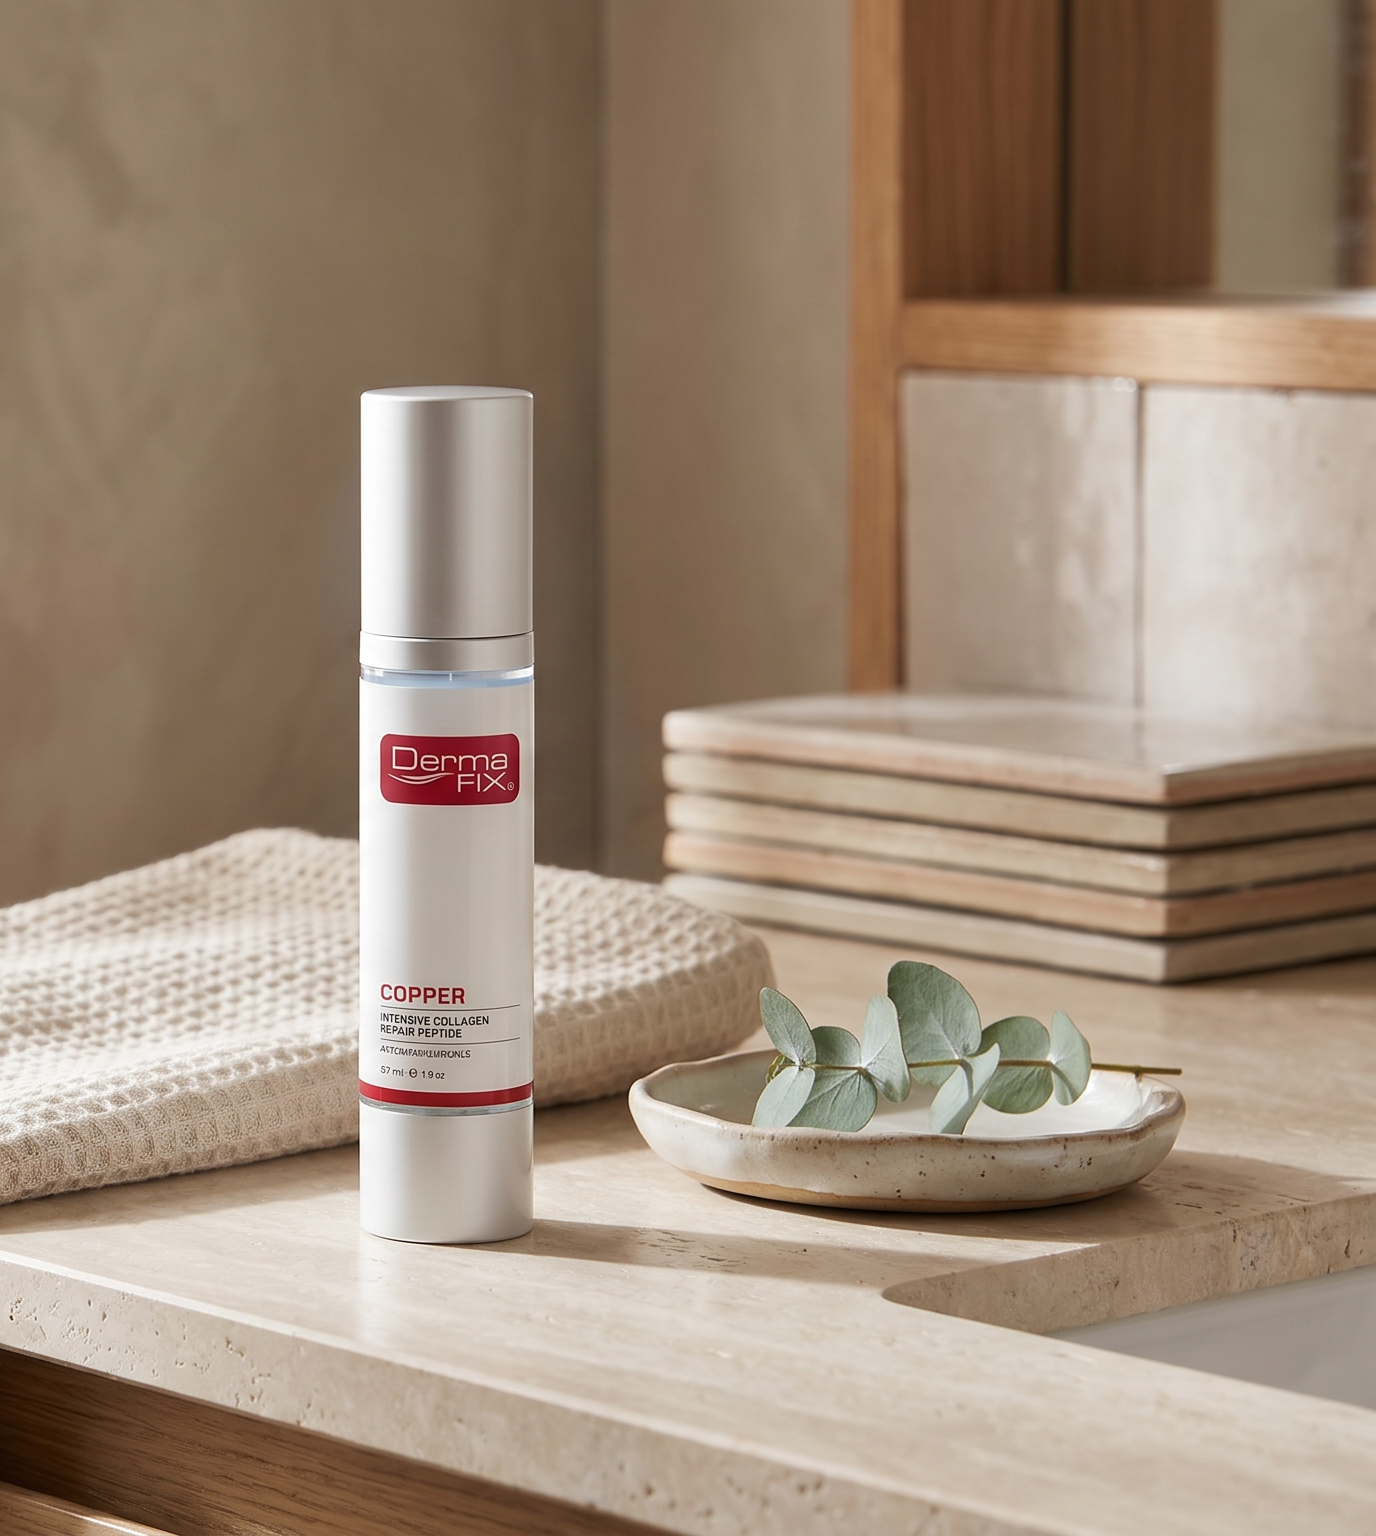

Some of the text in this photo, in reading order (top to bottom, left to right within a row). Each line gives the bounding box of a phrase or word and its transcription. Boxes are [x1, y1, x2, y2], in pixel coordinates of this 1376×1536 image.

[391, 745, 508, 772] Derma
[380, 983, 466, 1005] COPPER
[380, 1012, 490, 1026] INTENSIVE COLLAGEN
[380, 1024, 463, 1039] REPAIR PEPTIDE
